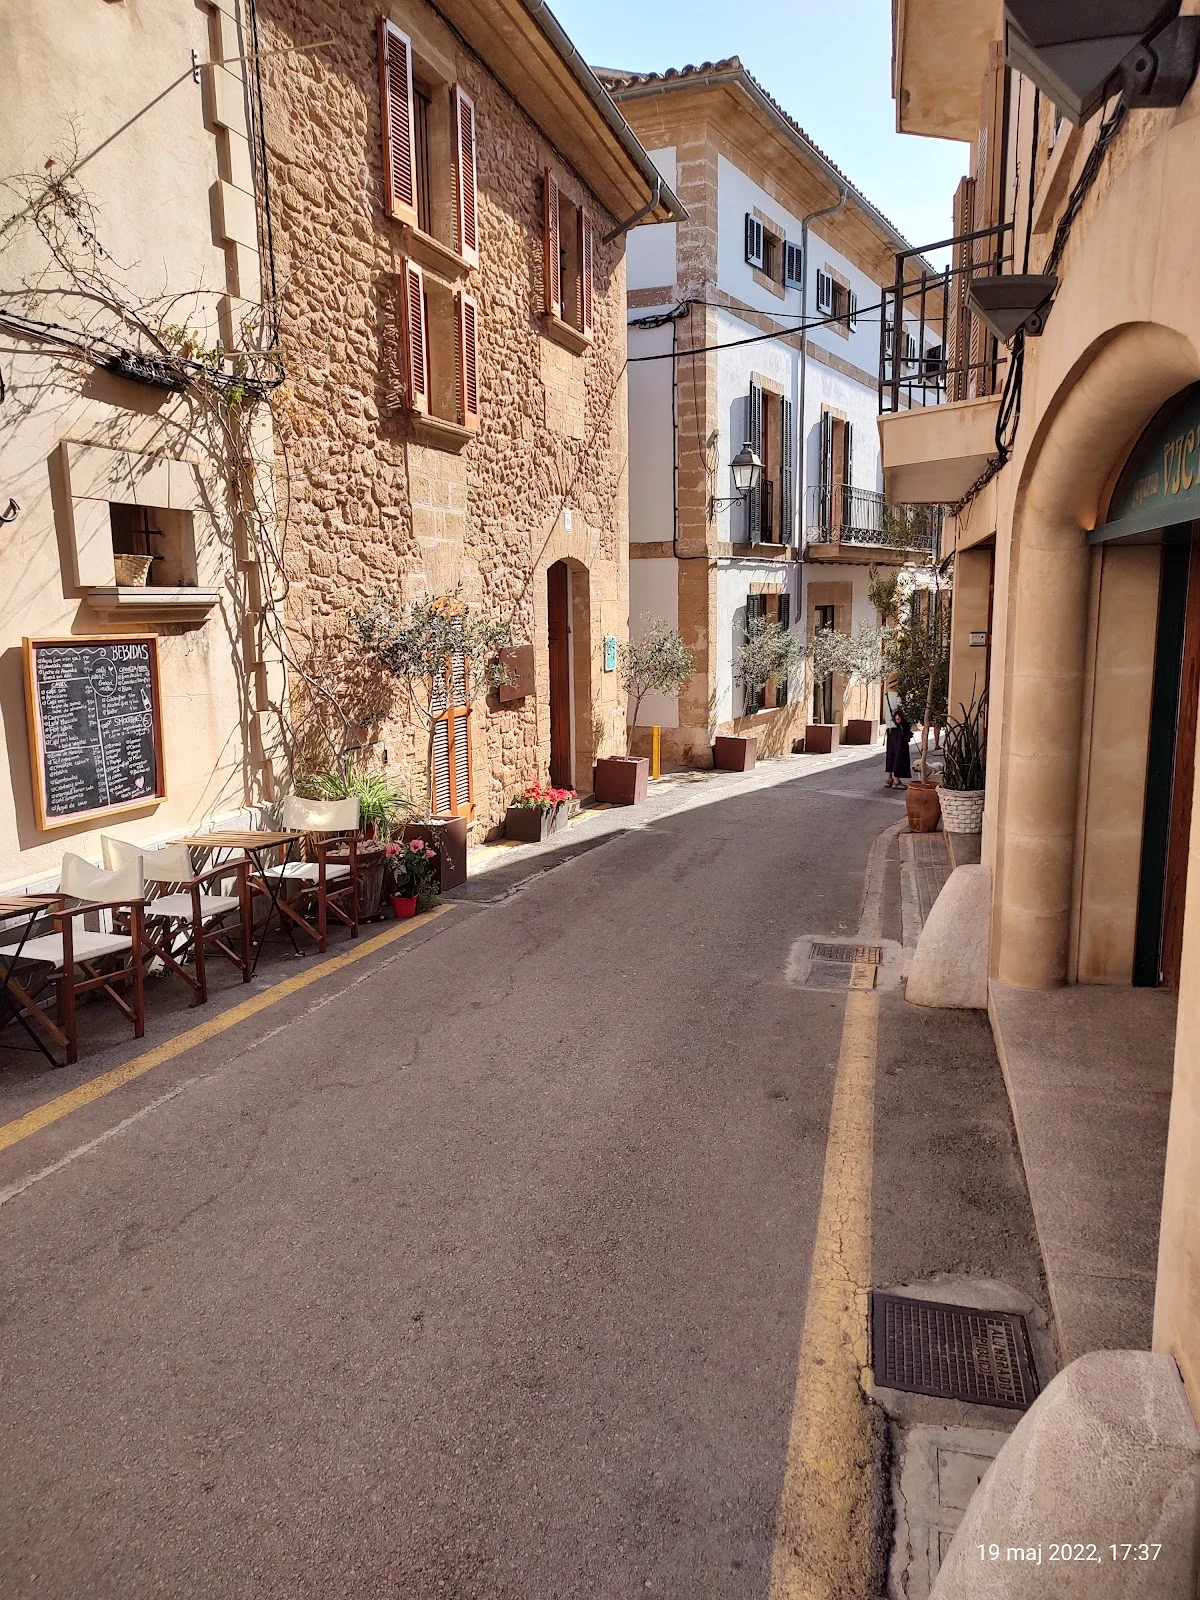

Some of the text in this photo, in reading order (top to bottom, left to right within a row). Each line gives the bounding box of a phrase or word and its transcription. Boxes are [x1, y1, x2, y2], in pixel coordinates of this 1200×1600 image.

[1163, 425, 1200, 497] VIC
[111, 645, 148, 661] BEBIDAS
[990, 1328, 1012, 1391] ALUMBRADO
